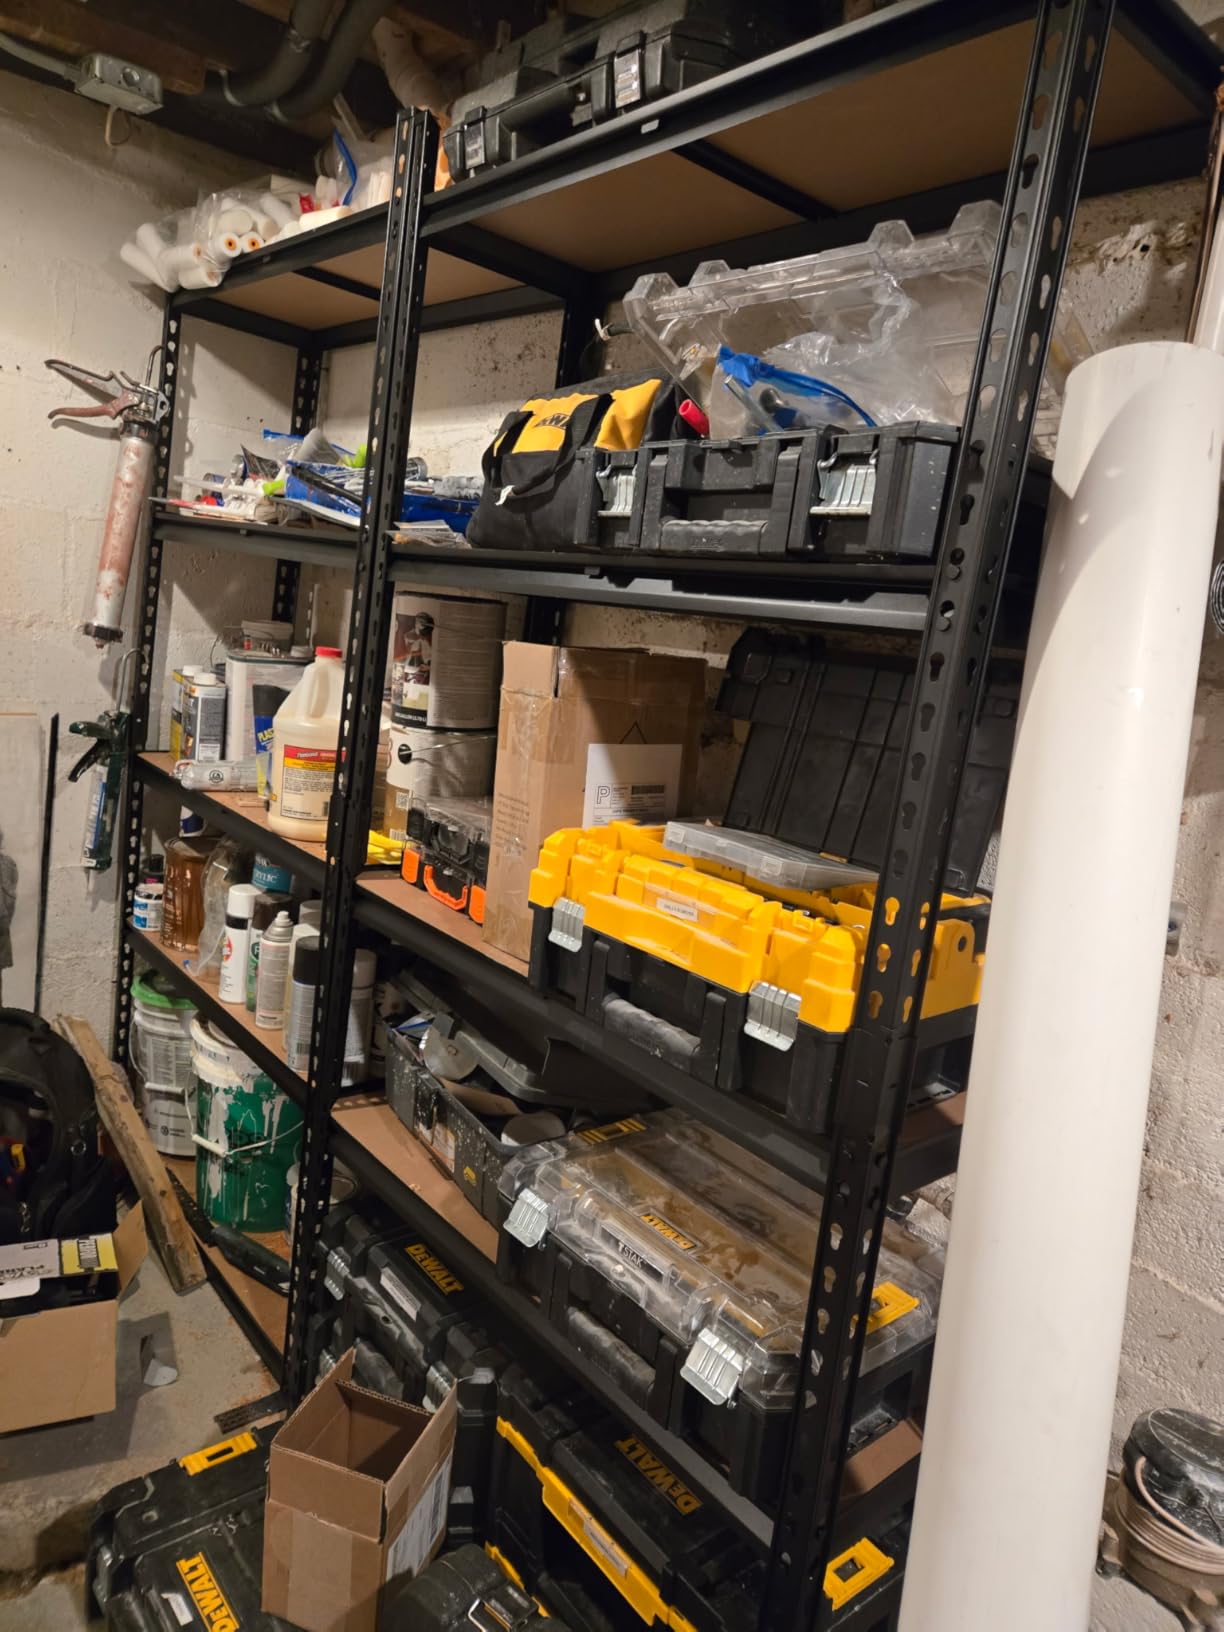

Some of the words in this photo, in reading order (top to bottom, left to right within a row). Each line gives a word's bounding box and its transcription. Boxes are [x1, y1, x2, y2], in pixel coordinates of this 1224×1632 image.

[597, 786, 611, 805] P
[641, 1214, 696, 1250] DEWALT
[405, 1244, 464, 1294] DEWALT
[614, 1436, 702, 1514] DEWALT
